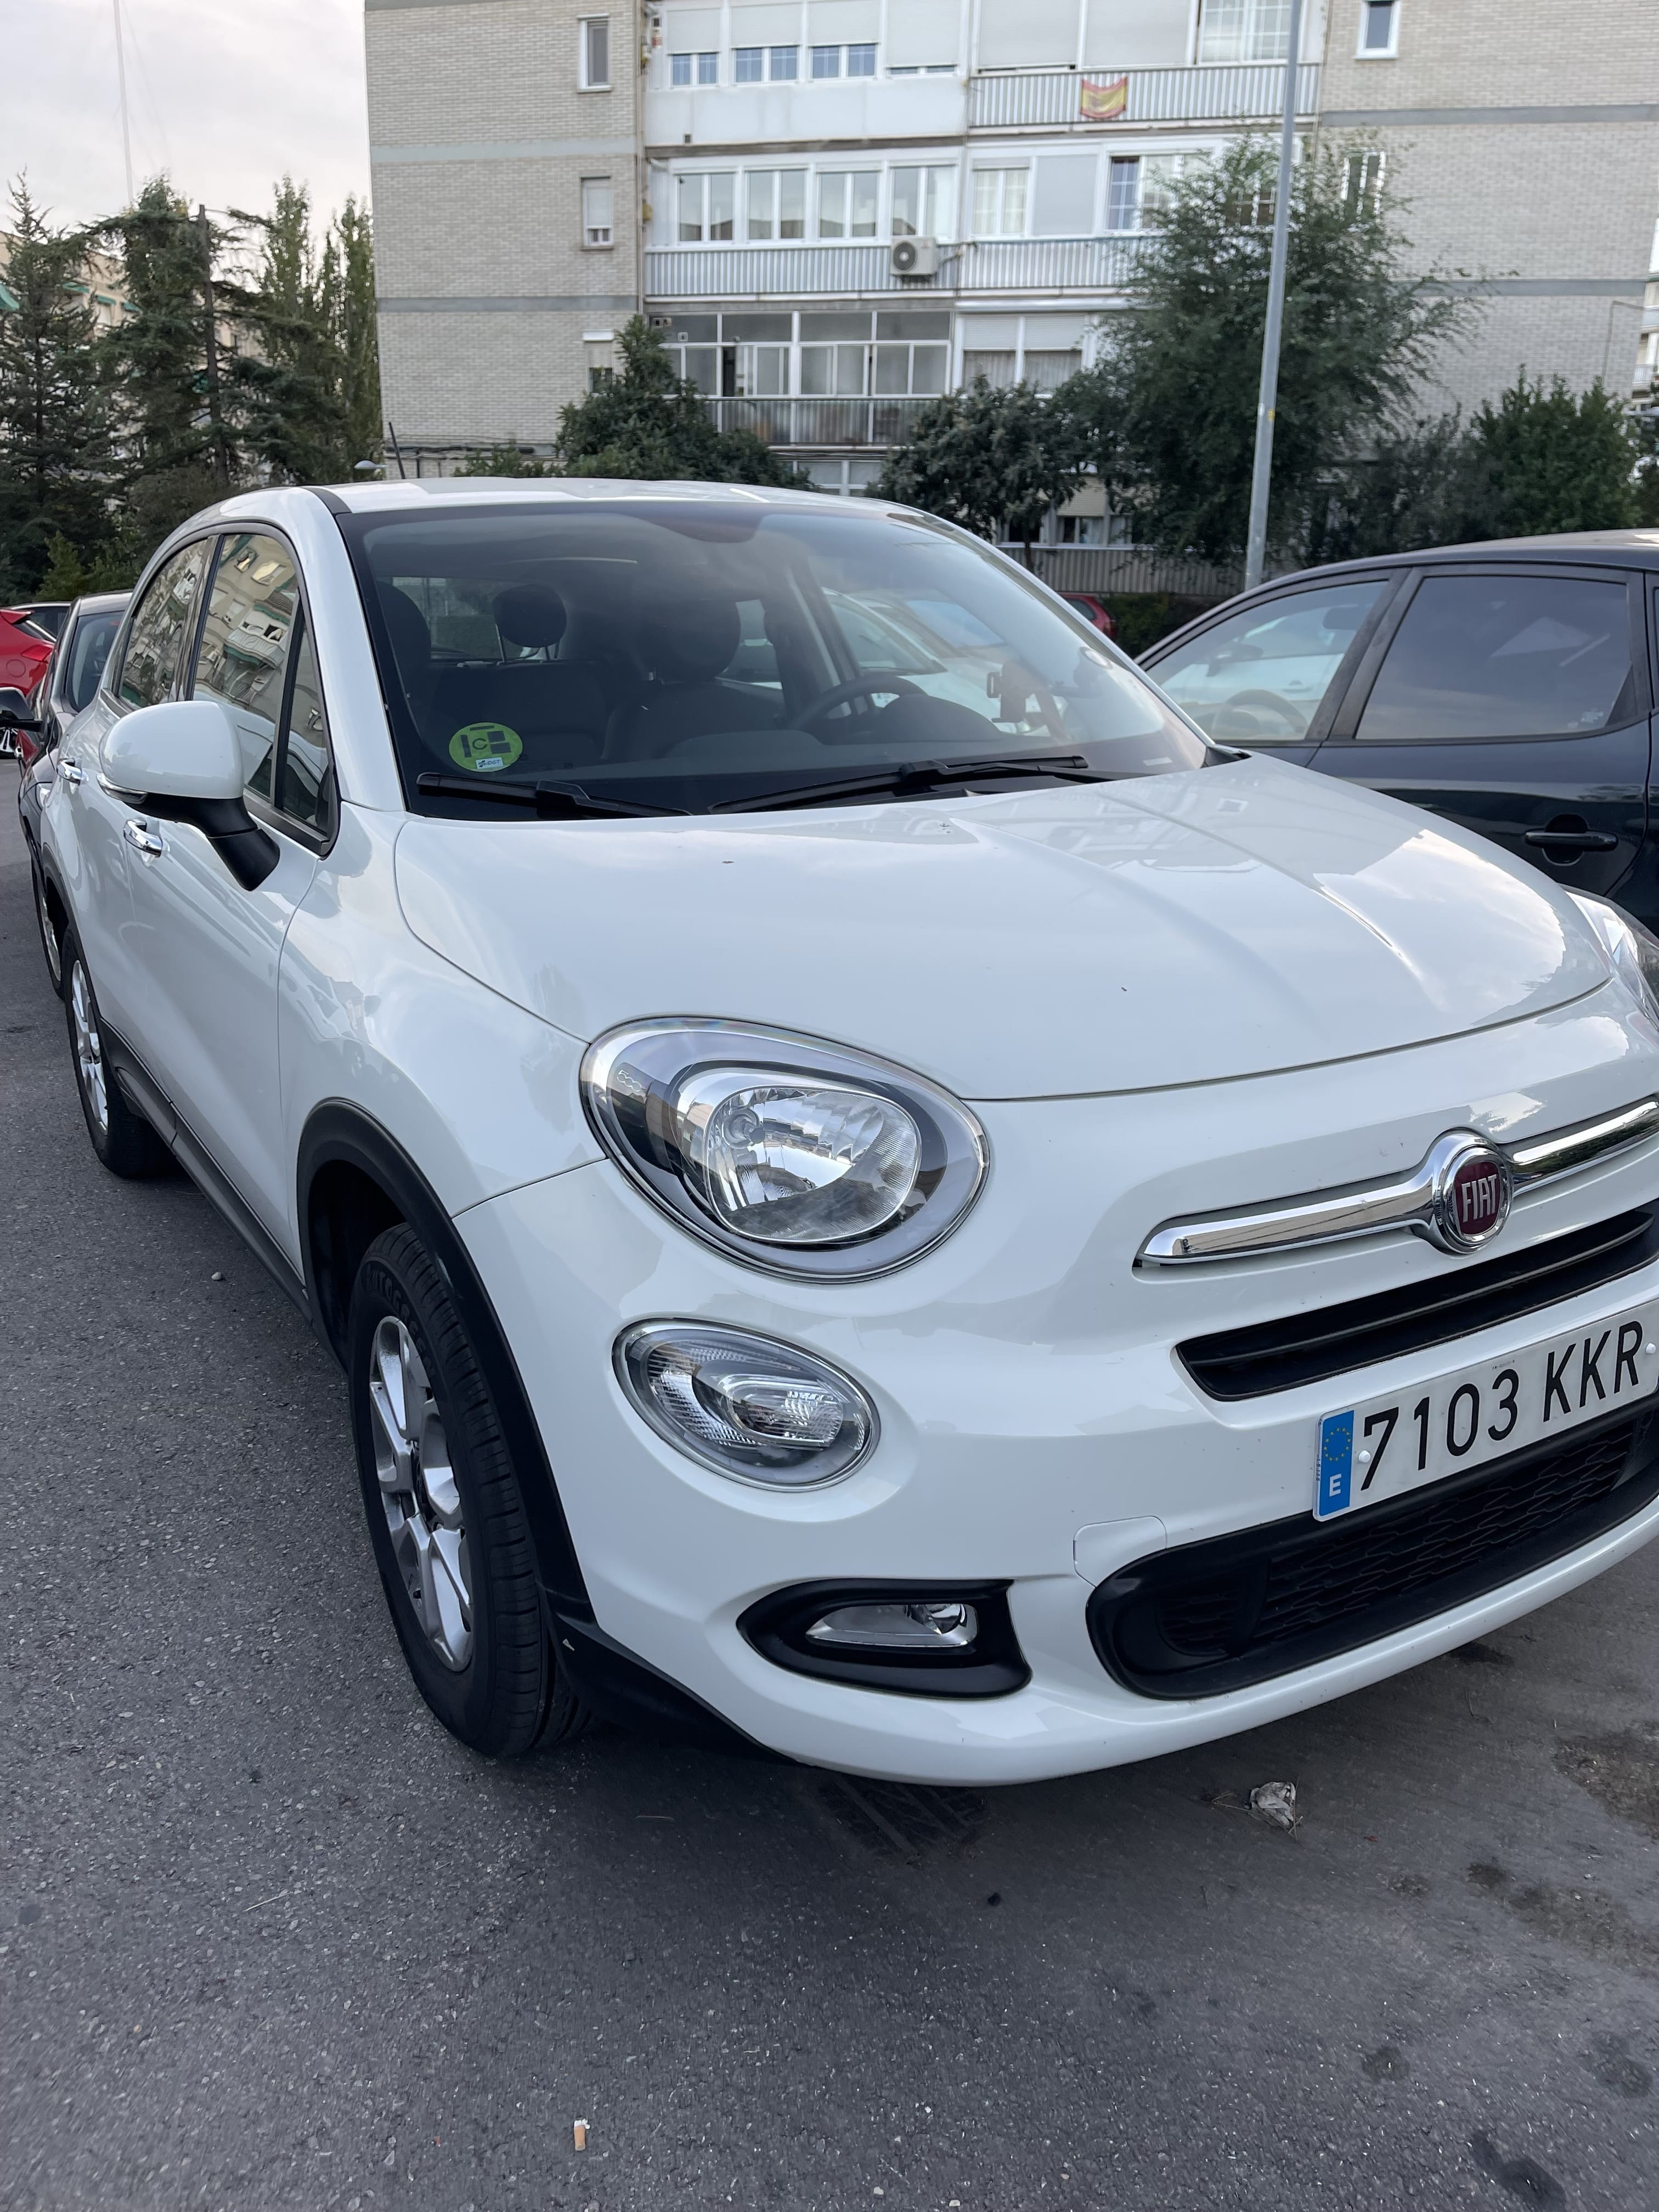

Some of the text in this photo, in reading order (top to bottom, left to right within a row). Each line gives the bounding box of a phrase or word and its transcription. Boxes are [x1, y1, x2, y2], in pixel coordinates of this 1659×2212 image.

[616, 1069, 642, 1092] 500
[1461, 1174, 1498, 1223] FIAT
[1360, 1321, 1643, 1492] 7103 KKR
[1329, 1473, 1342, 1497] E
